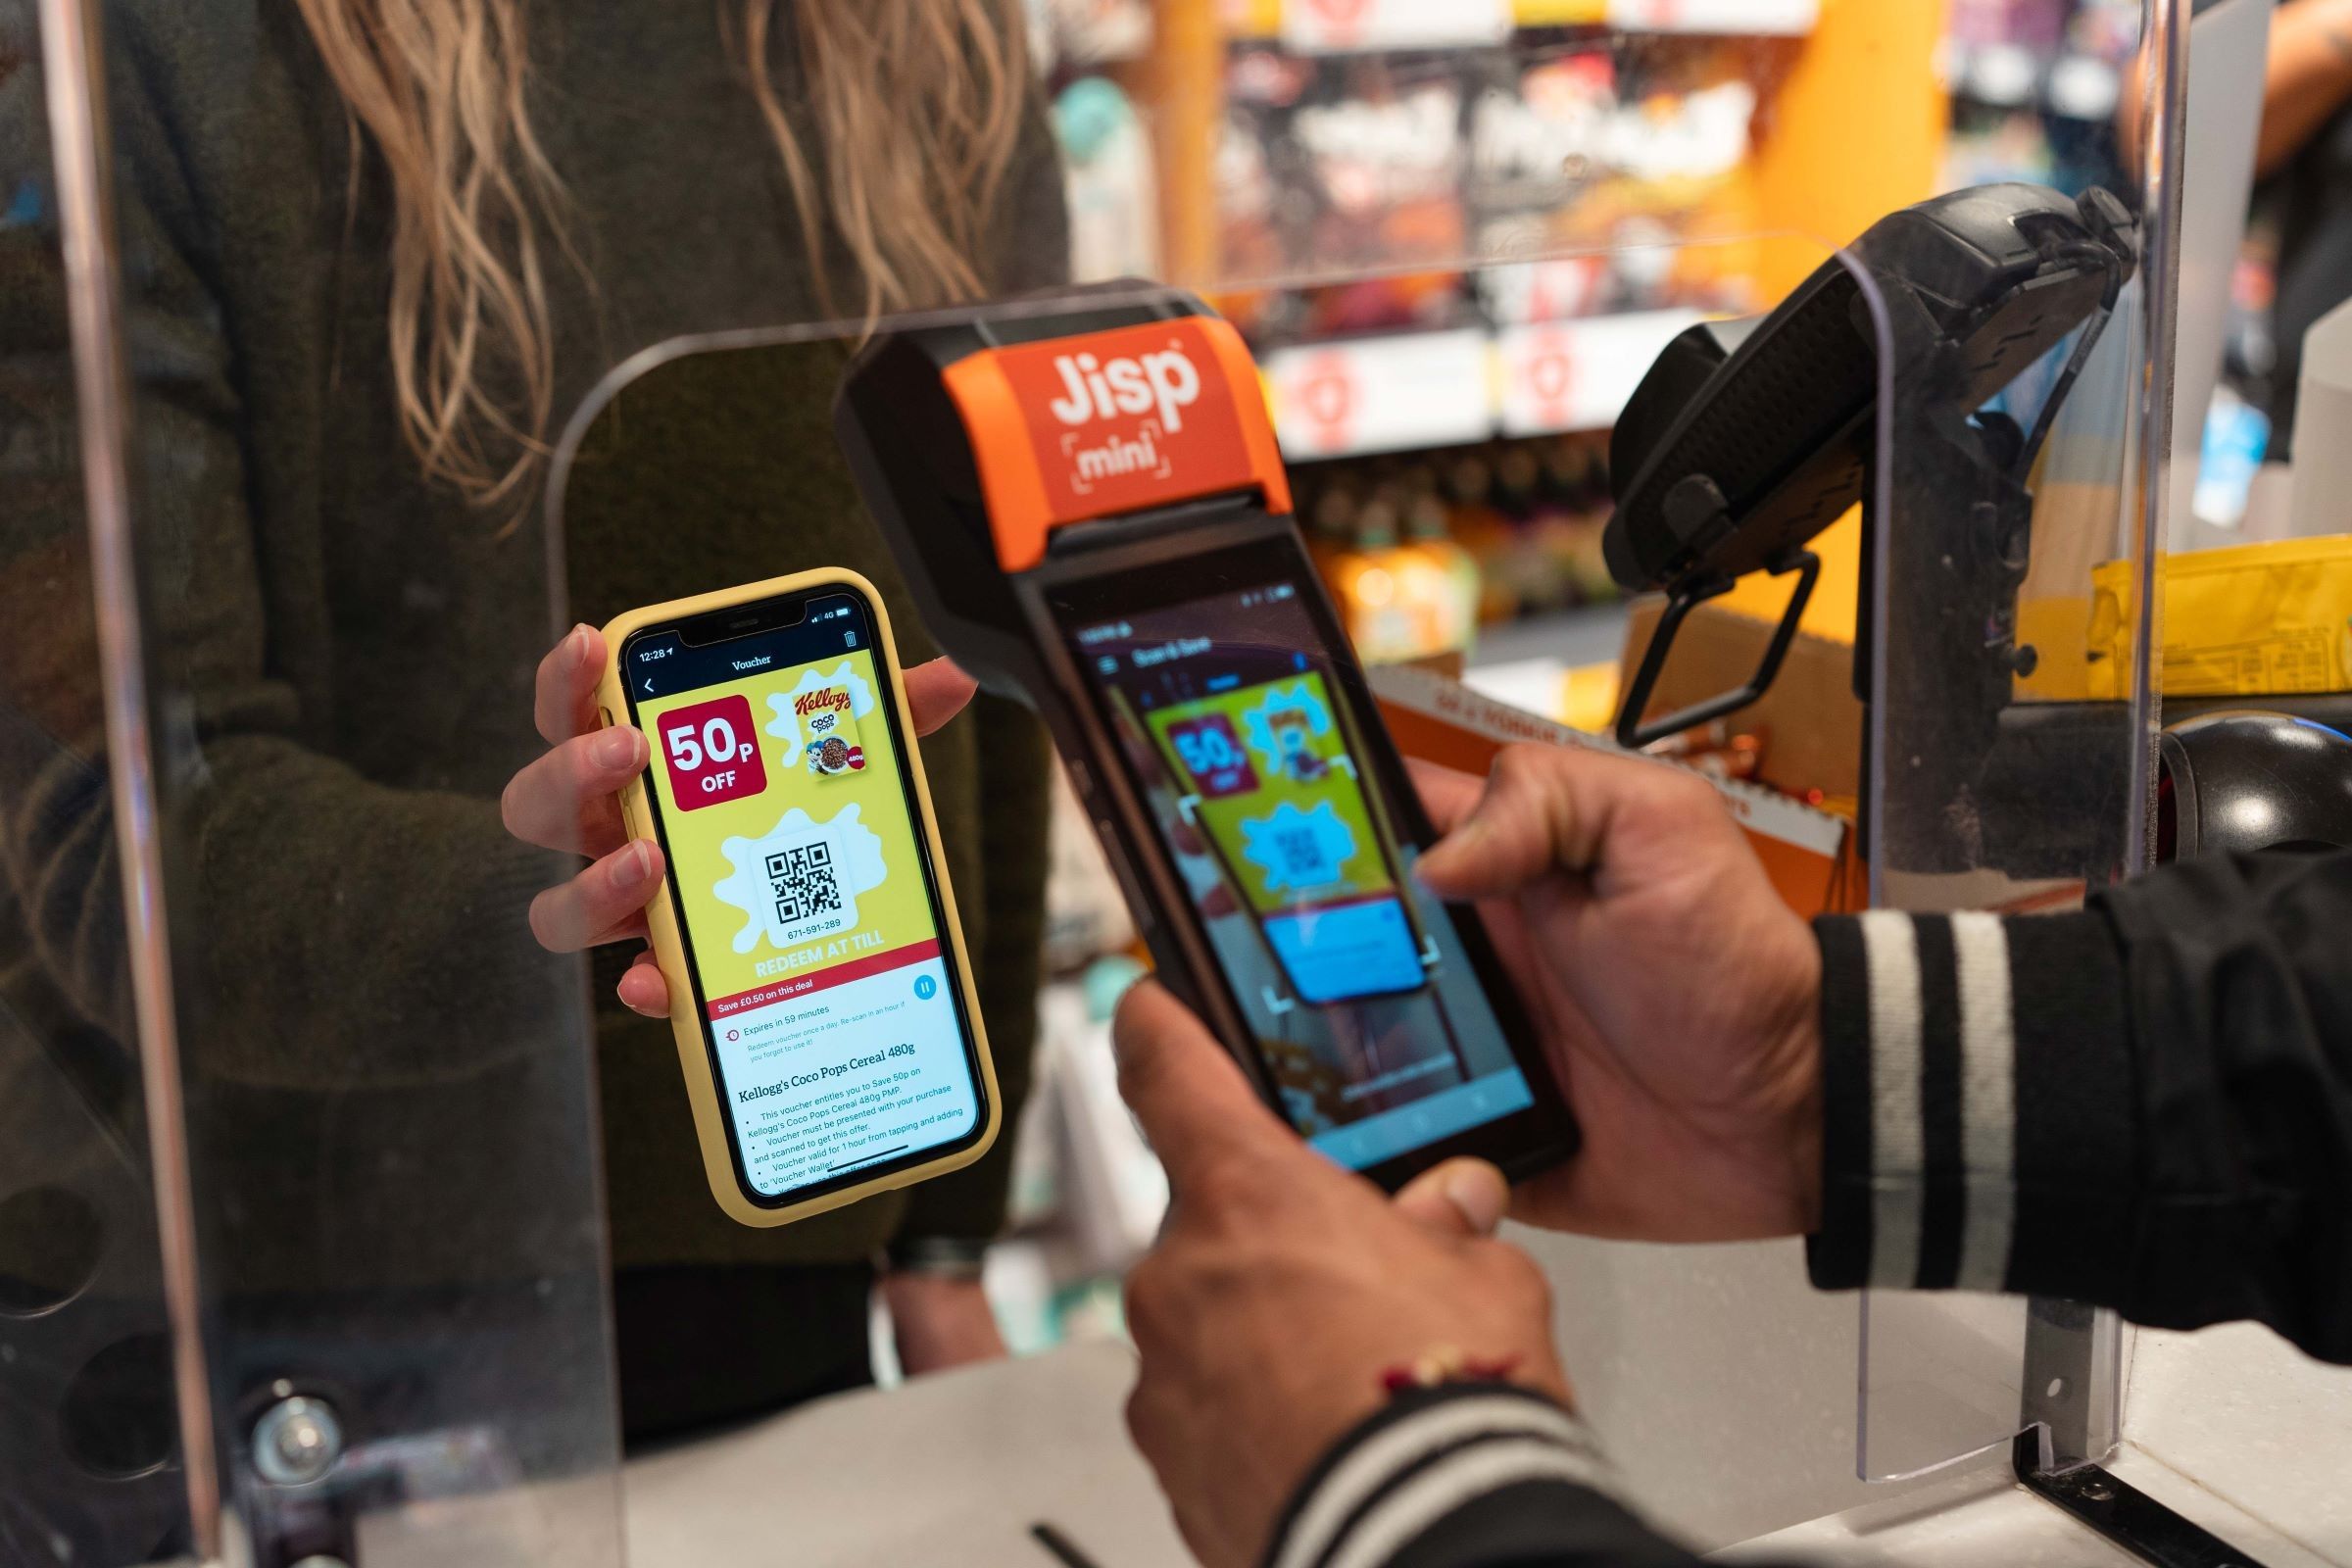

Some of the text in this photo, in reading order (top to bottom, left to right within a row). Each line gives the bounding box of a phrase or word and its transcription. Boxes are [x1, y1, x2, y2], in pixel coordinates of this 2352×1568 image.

[1051, 350, 1200, 433] Jisp
[1077, 430, 1157, 480] mini
[823, 611, 835, 619] 4G
[639, 649, 666, 662] 12:28
[731, 656, 771, 671] Voucher
[701, 769, 736, 793] OFF
[787, 918, 841, 940] 671-591-289
[755, 929, 885, 978] REDEEM AT TILL
[717, 978, 813, 1013] Save £0.50 on this deal
[743, 1005, 830, 1037] Expires in 59 minutes
[747, 1040, 775, 1053] Redeem
[775, 1031, 802, 1045] voucher
[803, 1027, 820, 1036] once
[840, 1013, 867, 1026] Re-scan
[884, 1004, 900, 1012] hour
[738, 1043, 915, 1103] Kellogg's Coco Pops Cereal 480g
[750, 1054, 763, 1064] you
[762, 1047, 784, 1058] forgot
[793, 1042, 806, 1051] use
[747, 1122, 786, 1139] Kellogg's
[786, 1115, 808, 1127] Coco
[808, 1108, 831, 1120] Pops
[831, 1099, 858, 1113] Cereal
[858, 1093, 881, 1104] 480g
[760, 1109, 779, 1121] This
[779, 1100, 812, 1115] voucher
[845, 1086, 861, 1098] you
[861, 1083, 871, 1092] to
[871, 1077, 892, 1088] Save
[893, 1071, 909, 1082] 50p
[765, 1085, 953, 1147] Voucher must be presented with your purchase
[754, 1123, 871, 1164] and scanned to get this offer.
[771, 1156, 807, 1172] Voucher
[808, 1148, 827, 1161] valid
[828, 1146, 840, 1155] for
[847, 1137, 866, 1149] hour
[867, 1131, 888, 1143] from
[888, 1121, 919, 1137] tapping
[919, 1114, 936, 1127] and
[936, 1107, 963, 1122] adding
